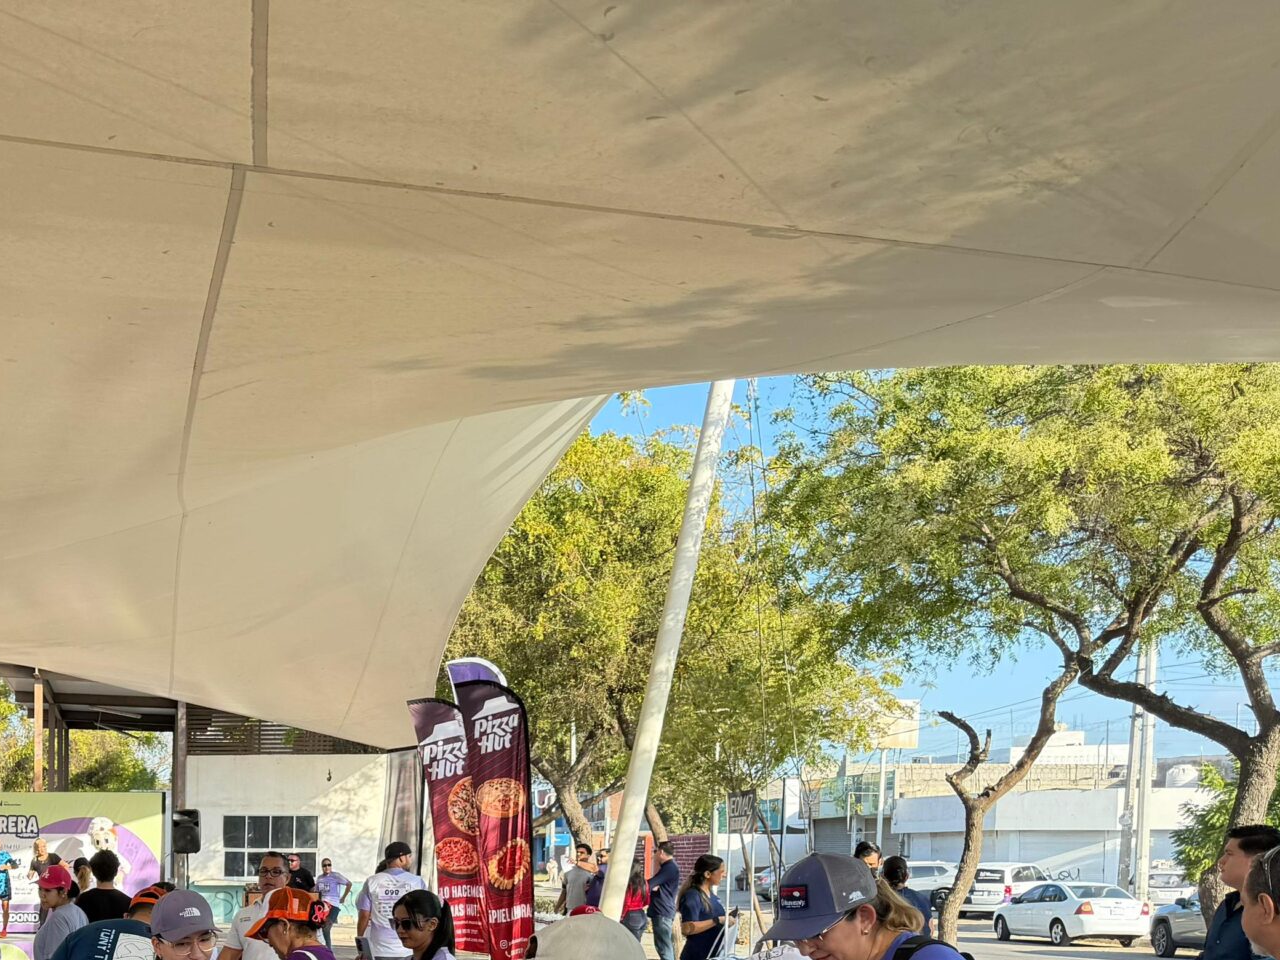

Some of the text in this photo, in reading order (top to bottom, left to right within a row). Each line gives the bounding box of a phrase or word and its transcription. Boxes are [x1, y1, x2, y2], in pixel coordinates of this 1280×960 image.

[474, 714, 520, 739] Pizza
[478, 733, 512, 755] Hut
[428, 759, 465, 781] Hut
